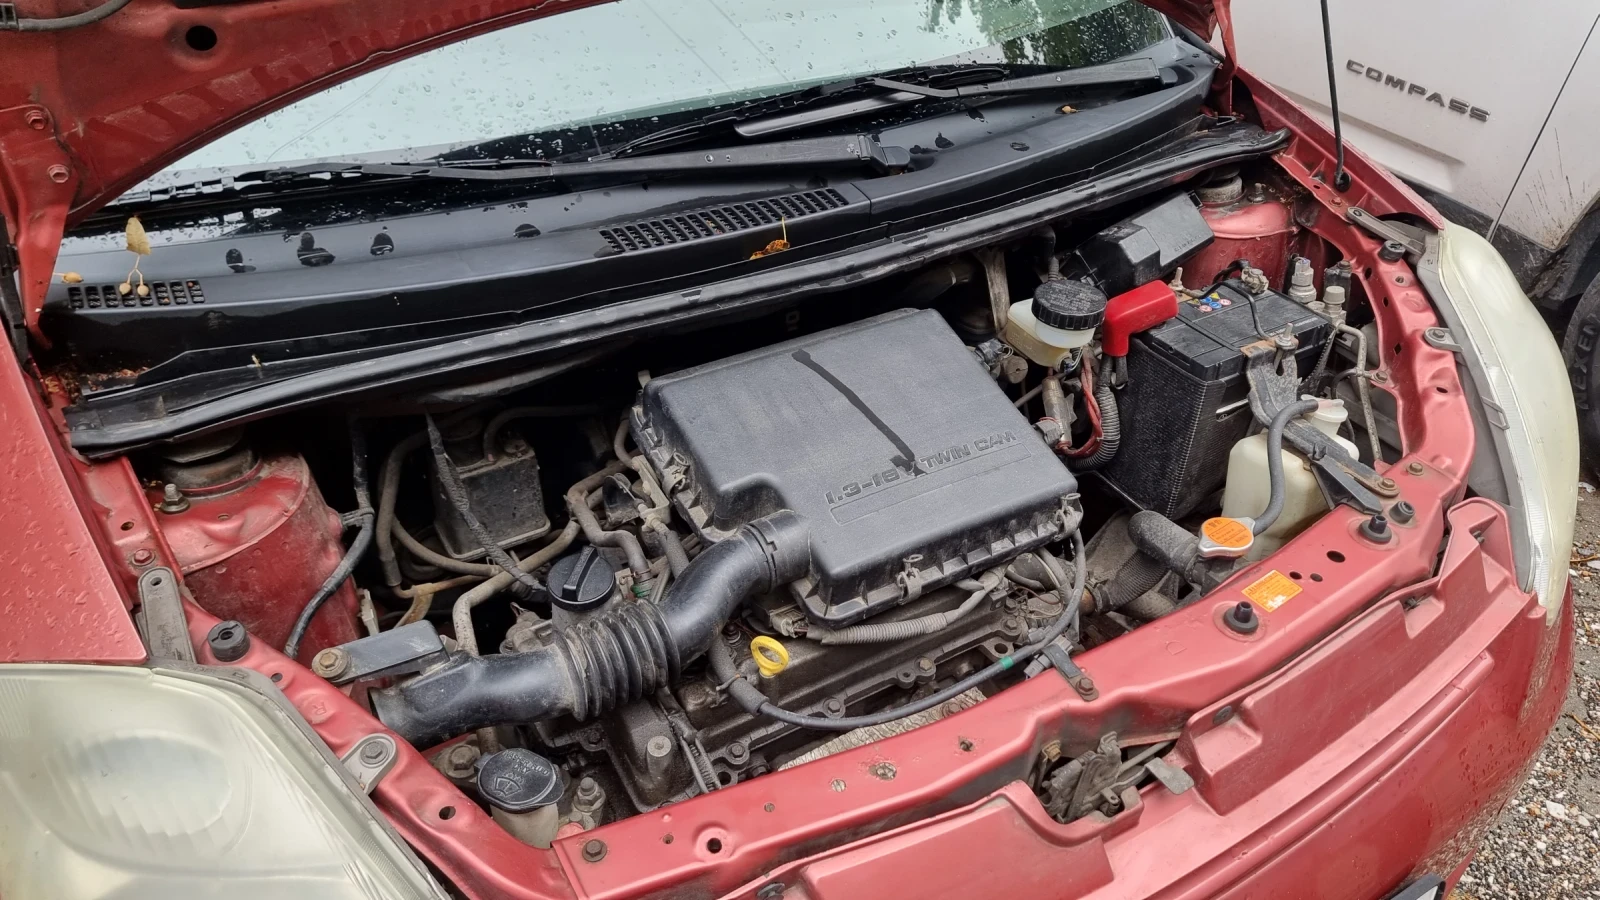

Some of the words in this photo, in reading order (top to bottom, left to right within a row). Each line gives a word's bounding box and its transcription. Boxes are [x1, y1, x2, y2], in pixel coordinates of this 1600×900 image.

[1346, 59, 1491, 122] COMPASS
[920, 443, 971, 470] TWIN
[973, 430, 1017, 452] CAM
